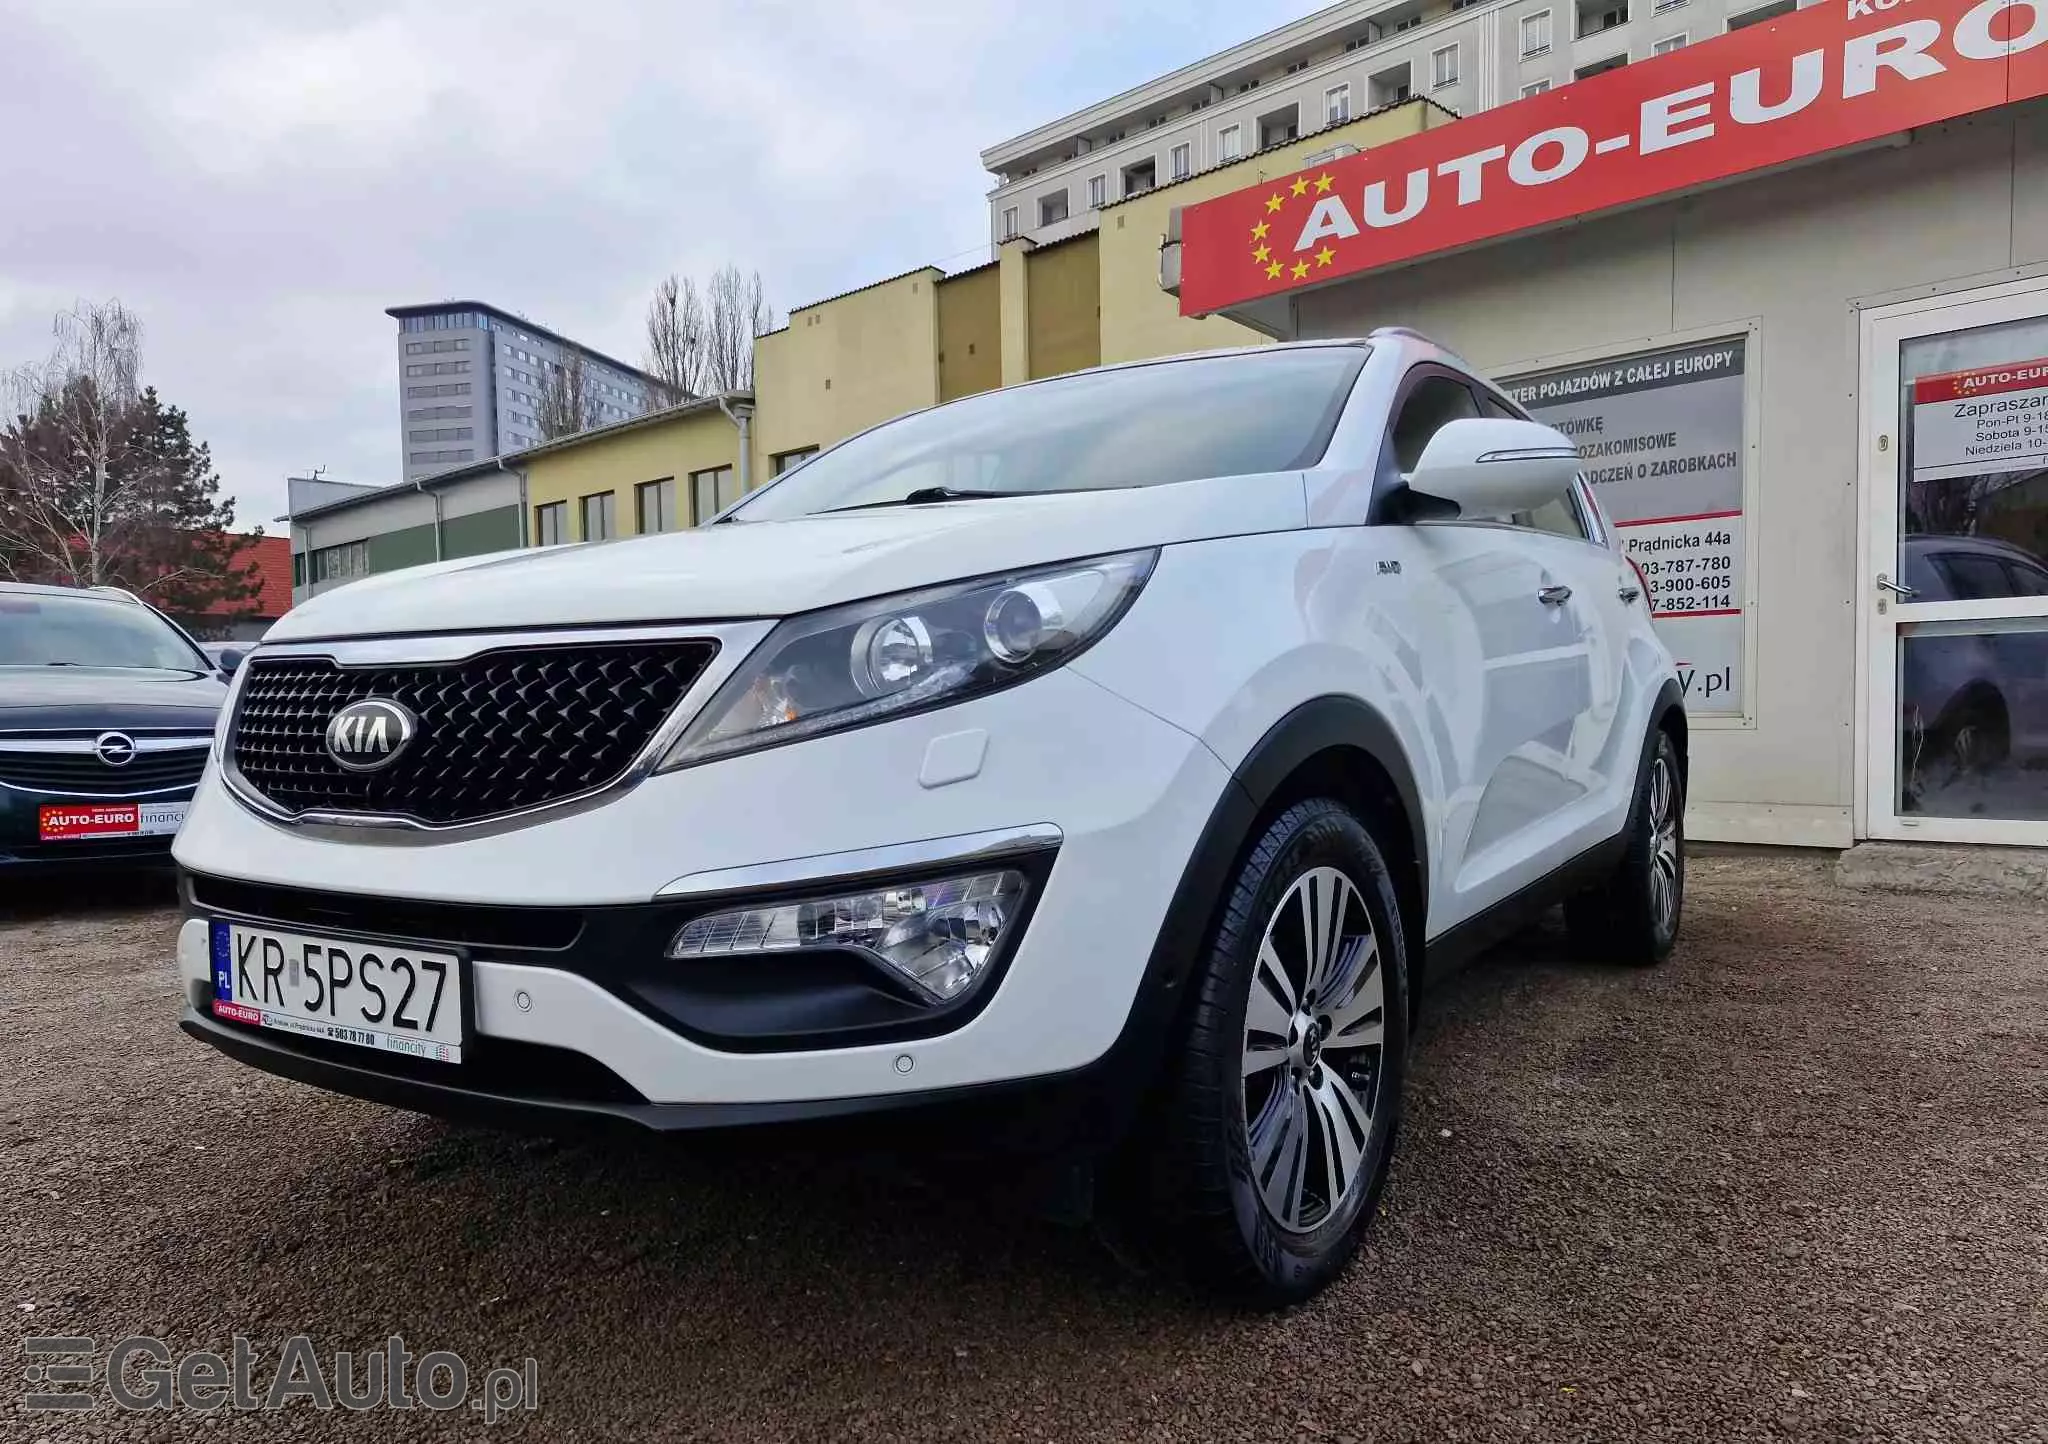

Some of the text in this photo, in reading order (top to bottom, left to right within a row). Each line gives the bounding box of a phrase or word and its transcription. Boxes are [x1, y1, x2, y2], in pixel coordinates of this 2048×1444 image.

[1294, 0, 2048, 252] AUTO-EURO
[1540, 371, 1611, 399] POJAZDÓW
[1614, 368, 1624, 386] Z
[1627, 361, 1670, 384] CAŁEJ
[1674, 350, 1733, 376] EUROPY
[1976, 429, 2020, 442] Sobota
[1965, 441, 2022, 457] Niedziela
[1637, 463, 1647, 478] O
[1651, 451, 1737, 477] ZAROBKACH
[1704, 531, 1731, 547] 44a
[334, 716, 389, 752] KIA
[49, 813, 134, 826] AUTO-EURO
[218, 970, 231, 989] PL
[237, 933, 447, 1032] KR 5PS27
[218, 1004, 259, 1022] AUTO-EURO
[387, 1034, 427, 1056] financity
